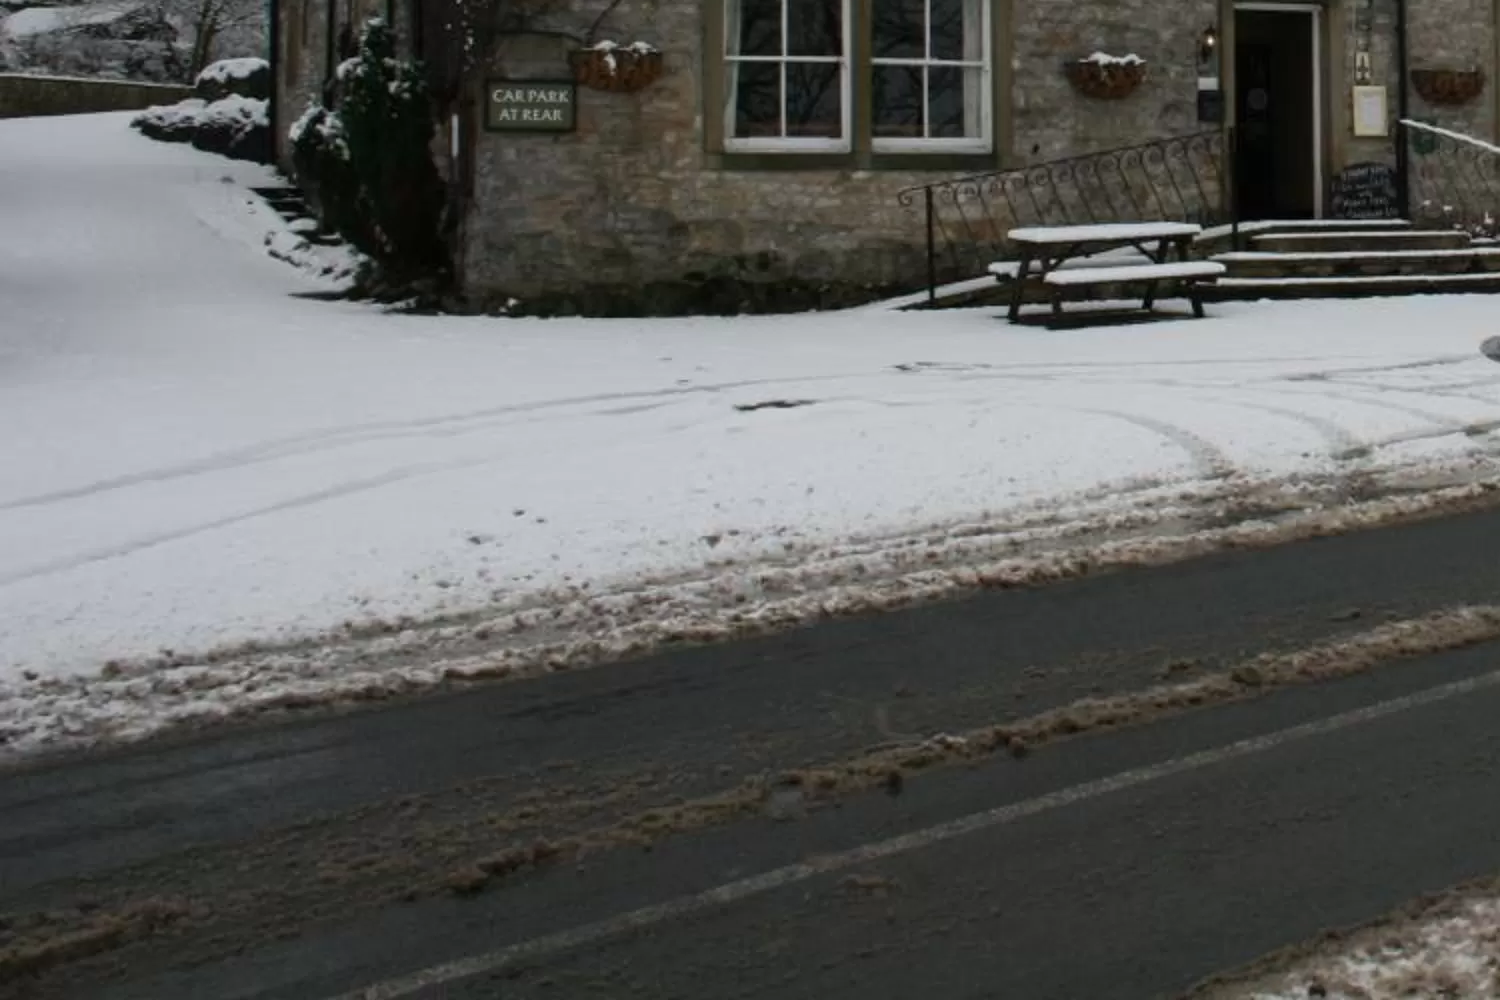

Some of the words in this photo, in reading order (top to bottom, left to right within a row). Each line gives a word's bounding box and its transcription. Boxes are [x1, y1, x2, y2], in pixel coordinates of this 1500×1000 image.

[492, 88, 525, 103] CAR
[527, 89, 569, 103] PARK
[499, 108, 519, 121] AT
[522, 108, 562, 121] REAR
